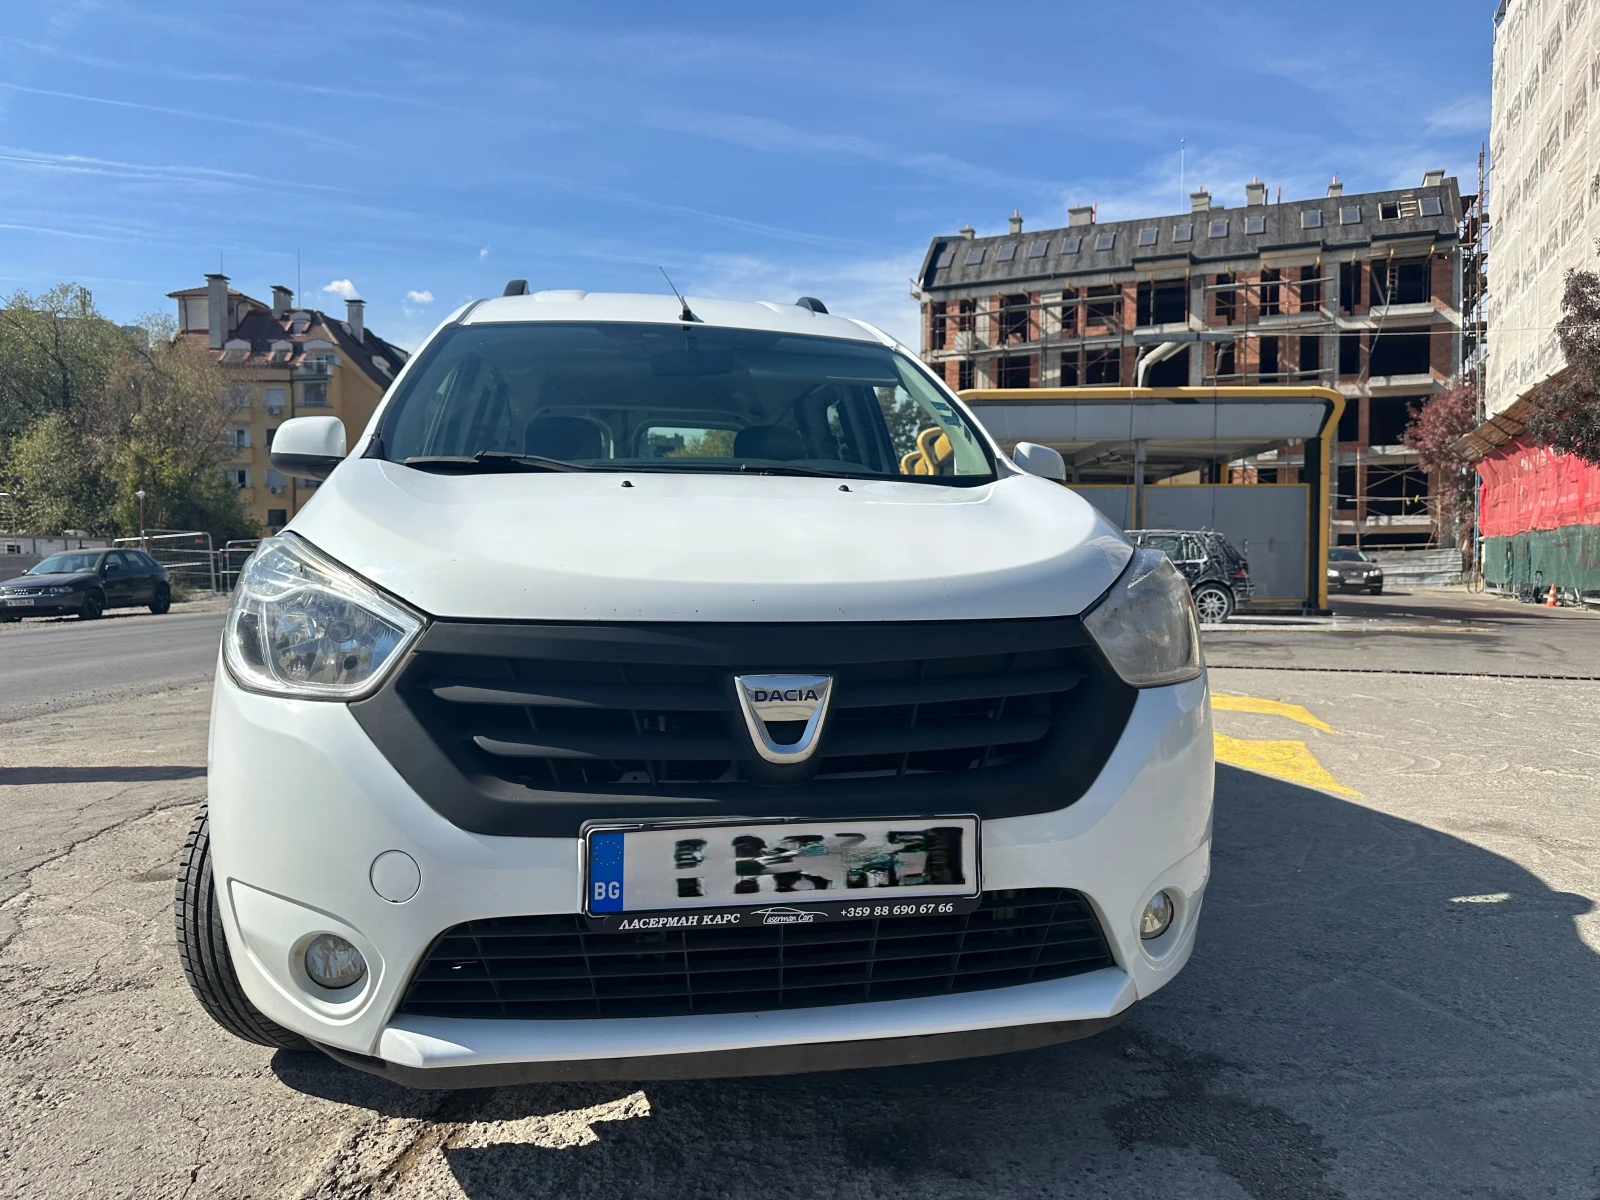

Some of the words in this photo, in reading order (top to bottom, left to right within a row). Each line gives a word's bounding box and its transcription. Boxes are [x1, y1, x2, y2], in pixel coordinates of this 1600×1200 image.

[754, 689, 819, 703] DACIA
[594, 881, 620, 901] BG
[798, 911, 814, 923] Cars
[840, 906, 870, 917] +359
[873, 905, 889, 916] 88
[892, 904, 916, 915] 690
[919, 903, 935, 914] 67
[938, 903, 954, 913] 66
[618, 915, 698, 930] ЛАСЕРМАН
[702, 913, 741, 925] КАРС
